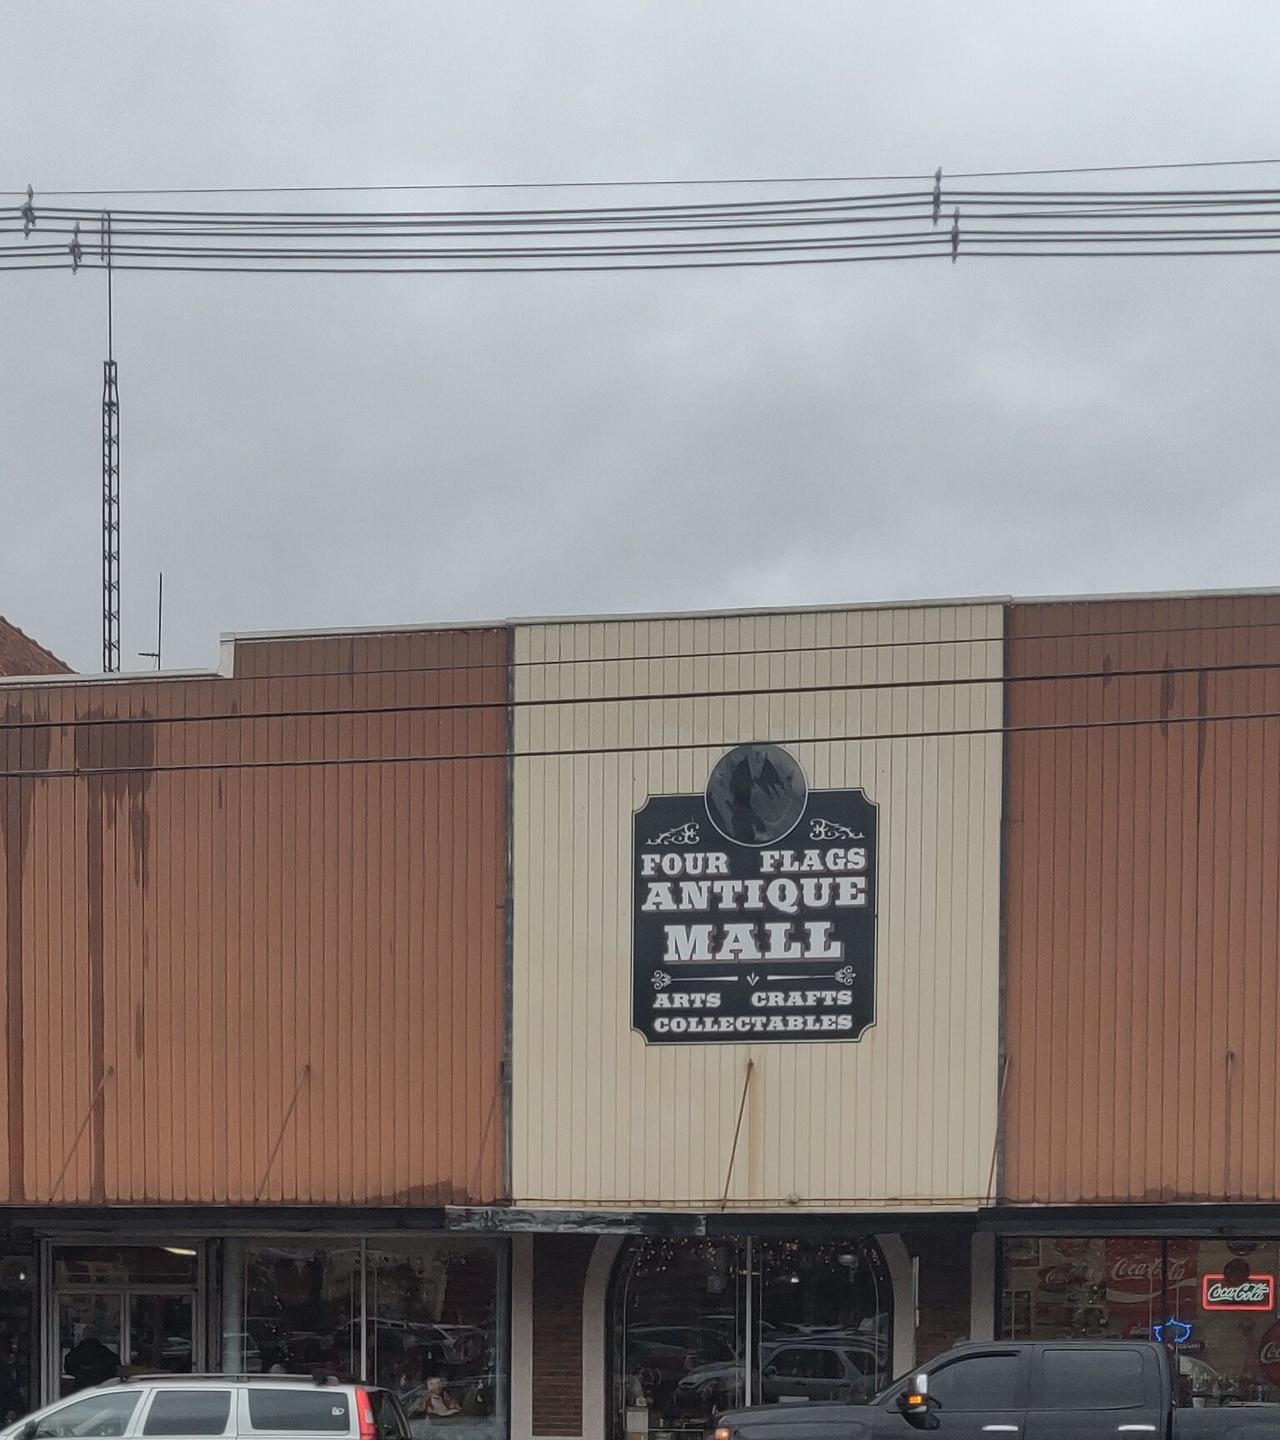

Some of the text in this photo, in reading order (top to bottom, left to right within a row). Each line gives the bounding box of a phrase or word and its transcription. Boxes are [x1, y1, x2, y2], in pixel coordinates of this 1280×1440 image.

[641, 848, 866, 875] FOUR FLAGS
[641, 876, 866, 914] ANTIQUE
[663, 921, 842, 962] MALL
[653, 990, 853, 1008] ARTS CRAFTS
[653, 1015, 853, 1032] COLLECTABLES
[1208, 1283, 1269, 1301] Coca-Cola
